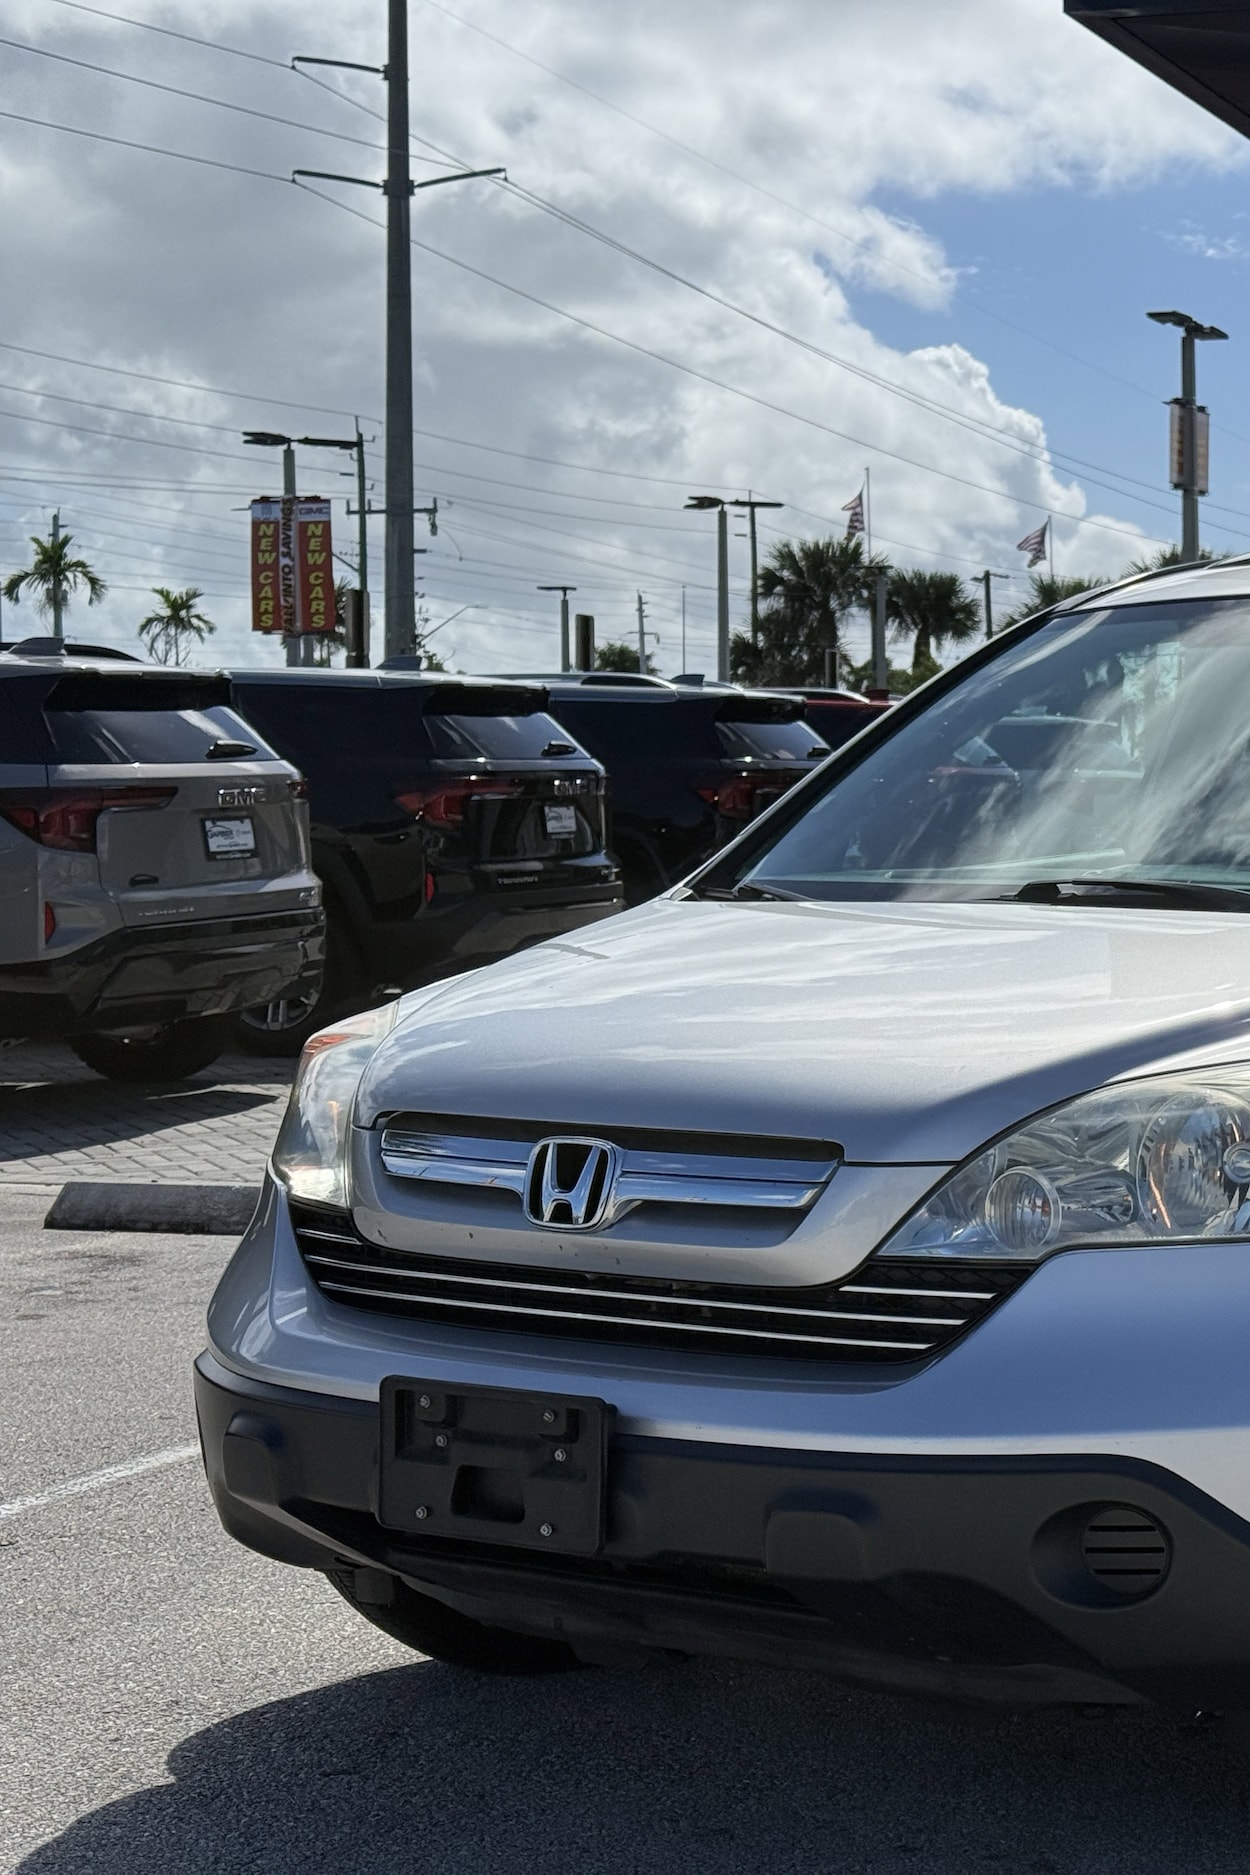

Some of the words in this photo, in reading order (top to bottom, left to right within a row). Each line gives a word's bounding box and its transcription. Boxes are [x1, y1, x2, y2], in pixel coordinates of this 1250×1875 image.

[281, 498, 293, 559] SAVINGS
[299, 507, 329, 515] GMC
[258, 524, 276, 564] NEW
[307, 524, 326, 564] NEW
[259, 571, 274, 627] CARS
[282, 564, 293, 598] INTO
[309, 571, 325, 628] CARS
